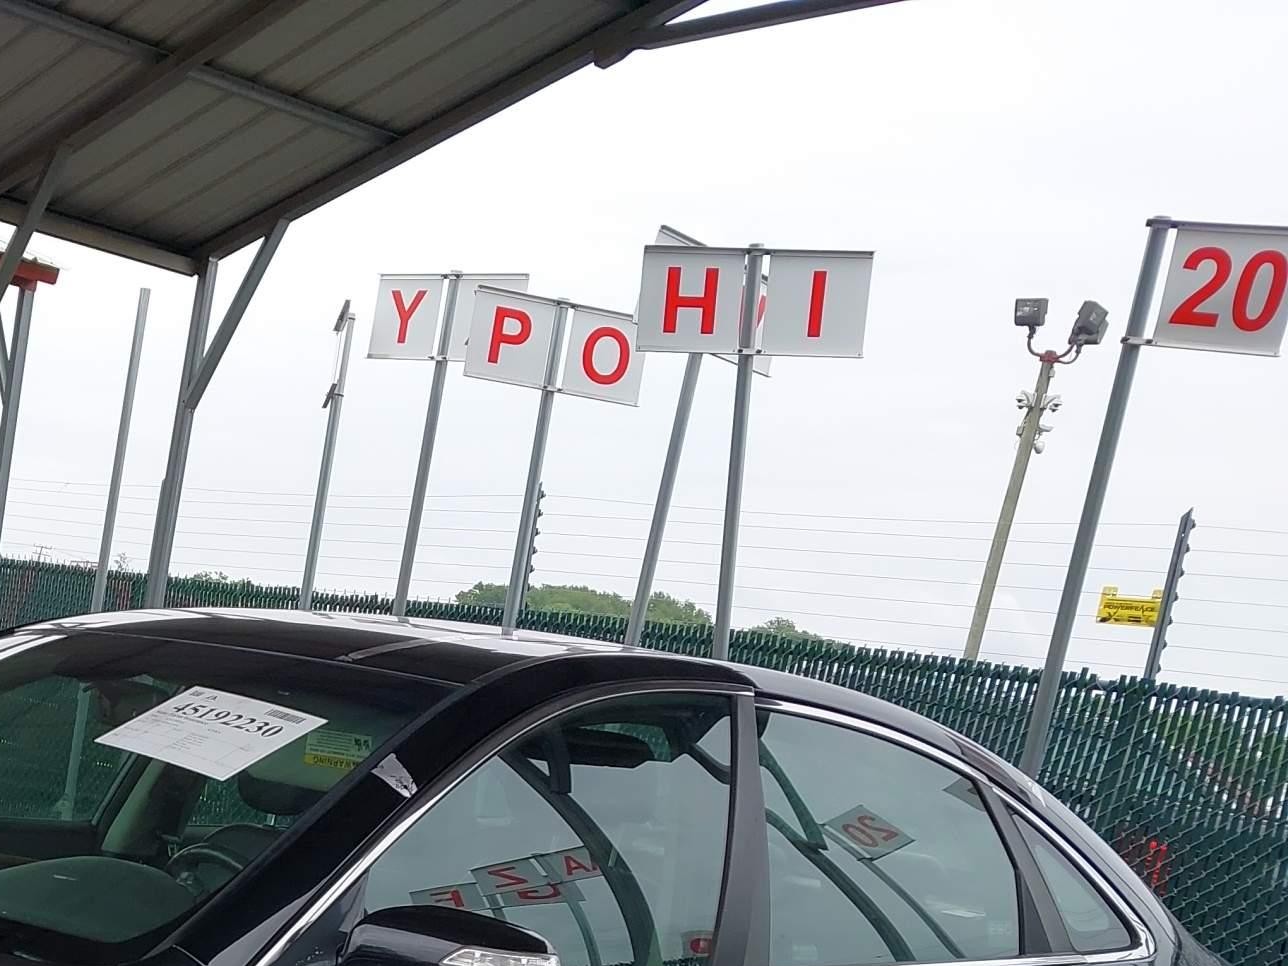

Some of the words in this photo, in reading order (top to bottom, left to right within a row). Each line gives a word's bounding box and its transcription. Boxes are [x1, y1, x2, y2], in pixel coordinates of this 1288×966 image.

[392, 290, 428, 344] Y
[663, 266, 719, 335] H
[1169, 247, 1288, 333] 20
[487, 306, 532, 364] P
[582, 326, 631, 385] O
[173, 702, 284, 738] 45192230
